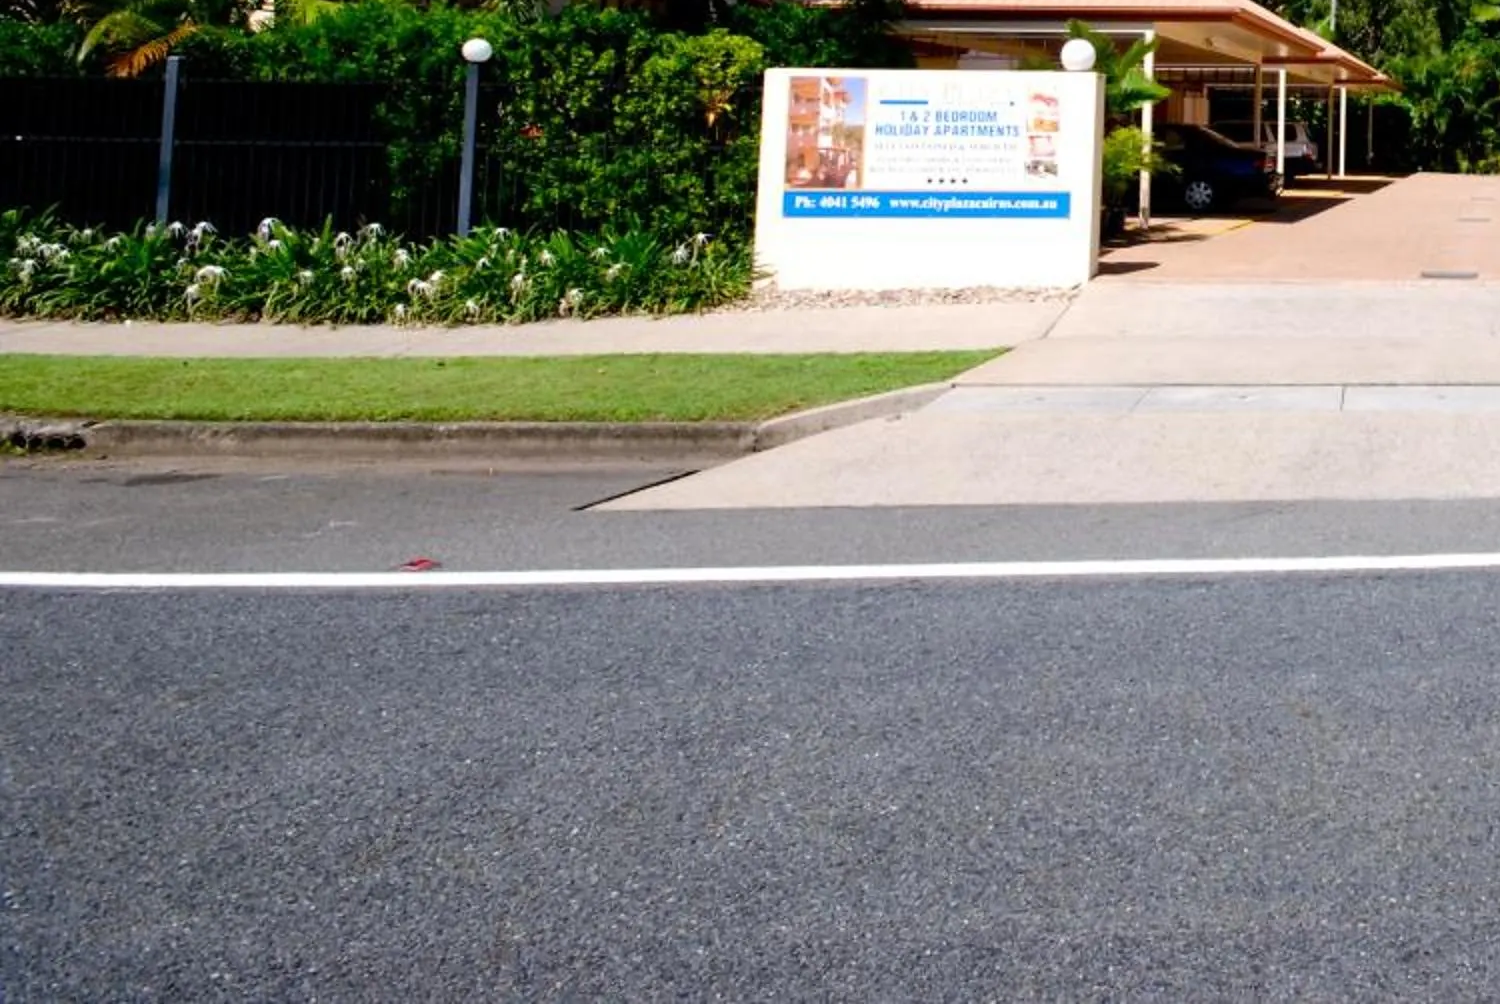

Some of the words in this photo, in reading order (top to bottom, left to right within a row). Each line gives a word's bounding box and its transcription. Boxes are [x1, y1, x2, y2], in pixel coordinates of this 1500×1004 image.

[923, 110, 931, 122] 2
[935, 110, 998, 123] BEDROOM
[875, 124, 929, 137] HOLIDAY
[933, 125, 1020, 137] APARTMENTS
[820, 195, 847, 209] 4041
[850, 195, 880, 209] 5496
